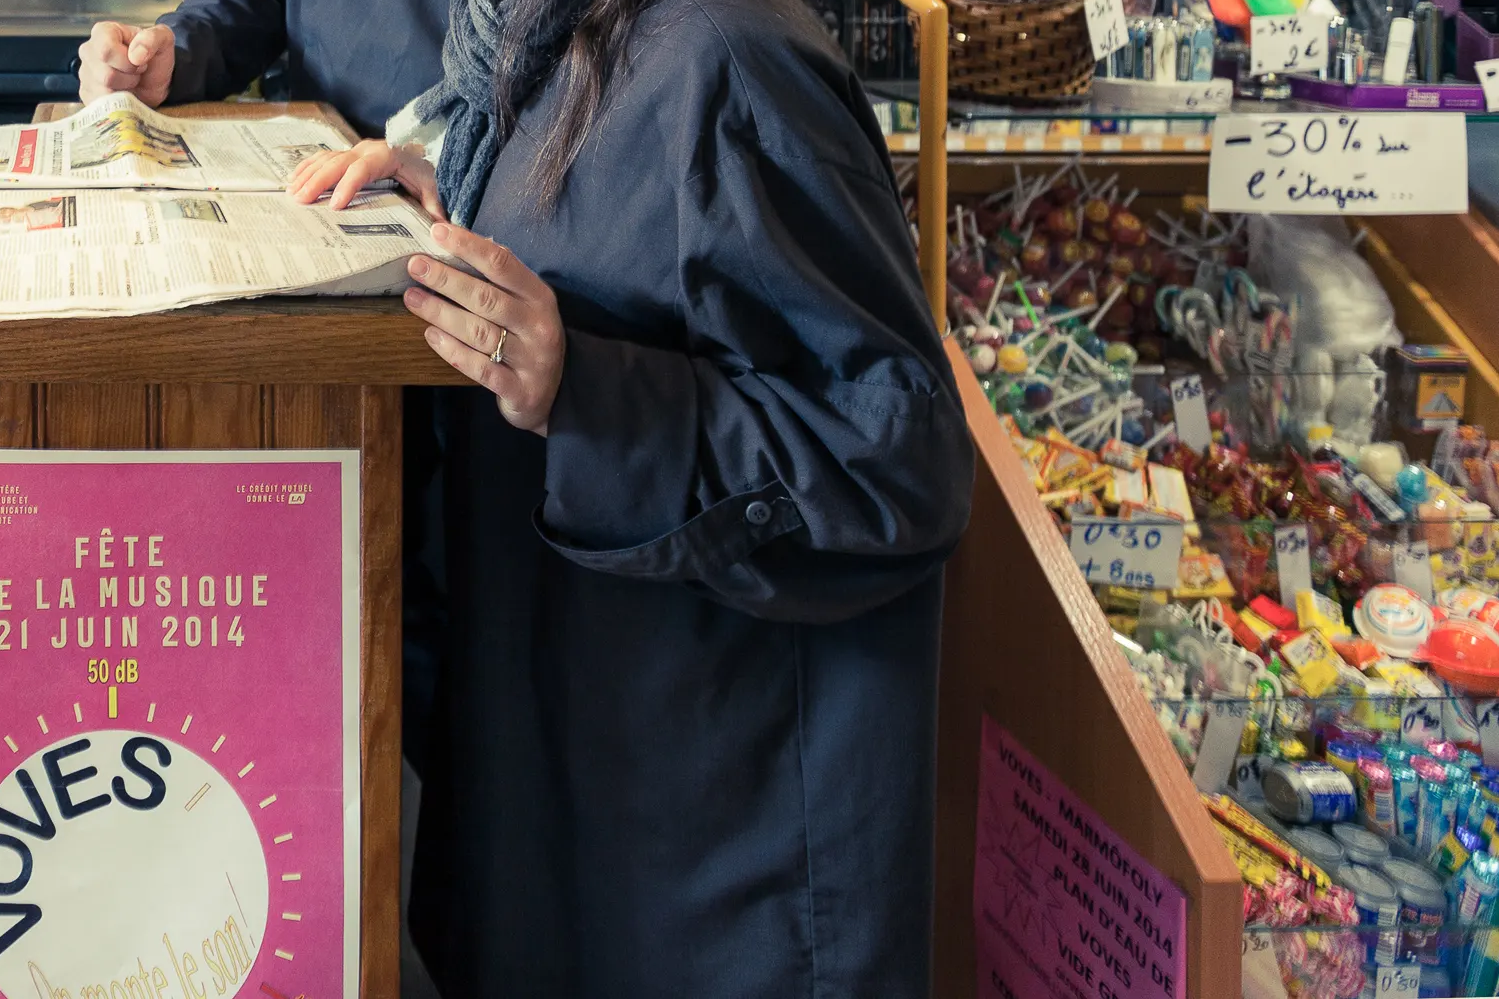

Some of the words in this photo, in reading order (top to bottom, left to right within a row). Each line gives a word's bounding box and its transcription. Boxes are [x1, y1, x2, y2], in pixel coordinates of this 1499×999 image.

[19, 496, 28, 504] ET
[236, 485, 246, 493] LE
[249, 483, 278, 493] CRÉDIT
[282, 484, 313, 492] MUTUEL
[246, 494, 272, 503] DONNE
[276, 494, 285, 503] LE
[75, 528, 164, 568] FÊTE
[36, 578, 76, 610] LA
[99, 575, 268, 608] MUSIQUE
[51, 616, 138, 649] JUIN
[161, 615, 245, 647] 2014
[87, 659, 109, 684] 50
[115, 658, 139, 684] dB
[1000, 741, 1042, 795] VOVES
[1014, 790, 1067, 855] SAMEDI
[1072, 849, 1090, 876] 28
[1094, 870, 1129, 915] JUIN
[1134, 909, 1173, 960] 2014
[1054, 865, 1094, 915] PLAN
[1099, 907, 1146, 969] D'EAU
[1152, 964, 1173, 998] DE
[1058, 938, 1094, 984] VIDE
[1078, 922, 1132, 989] VOVES
